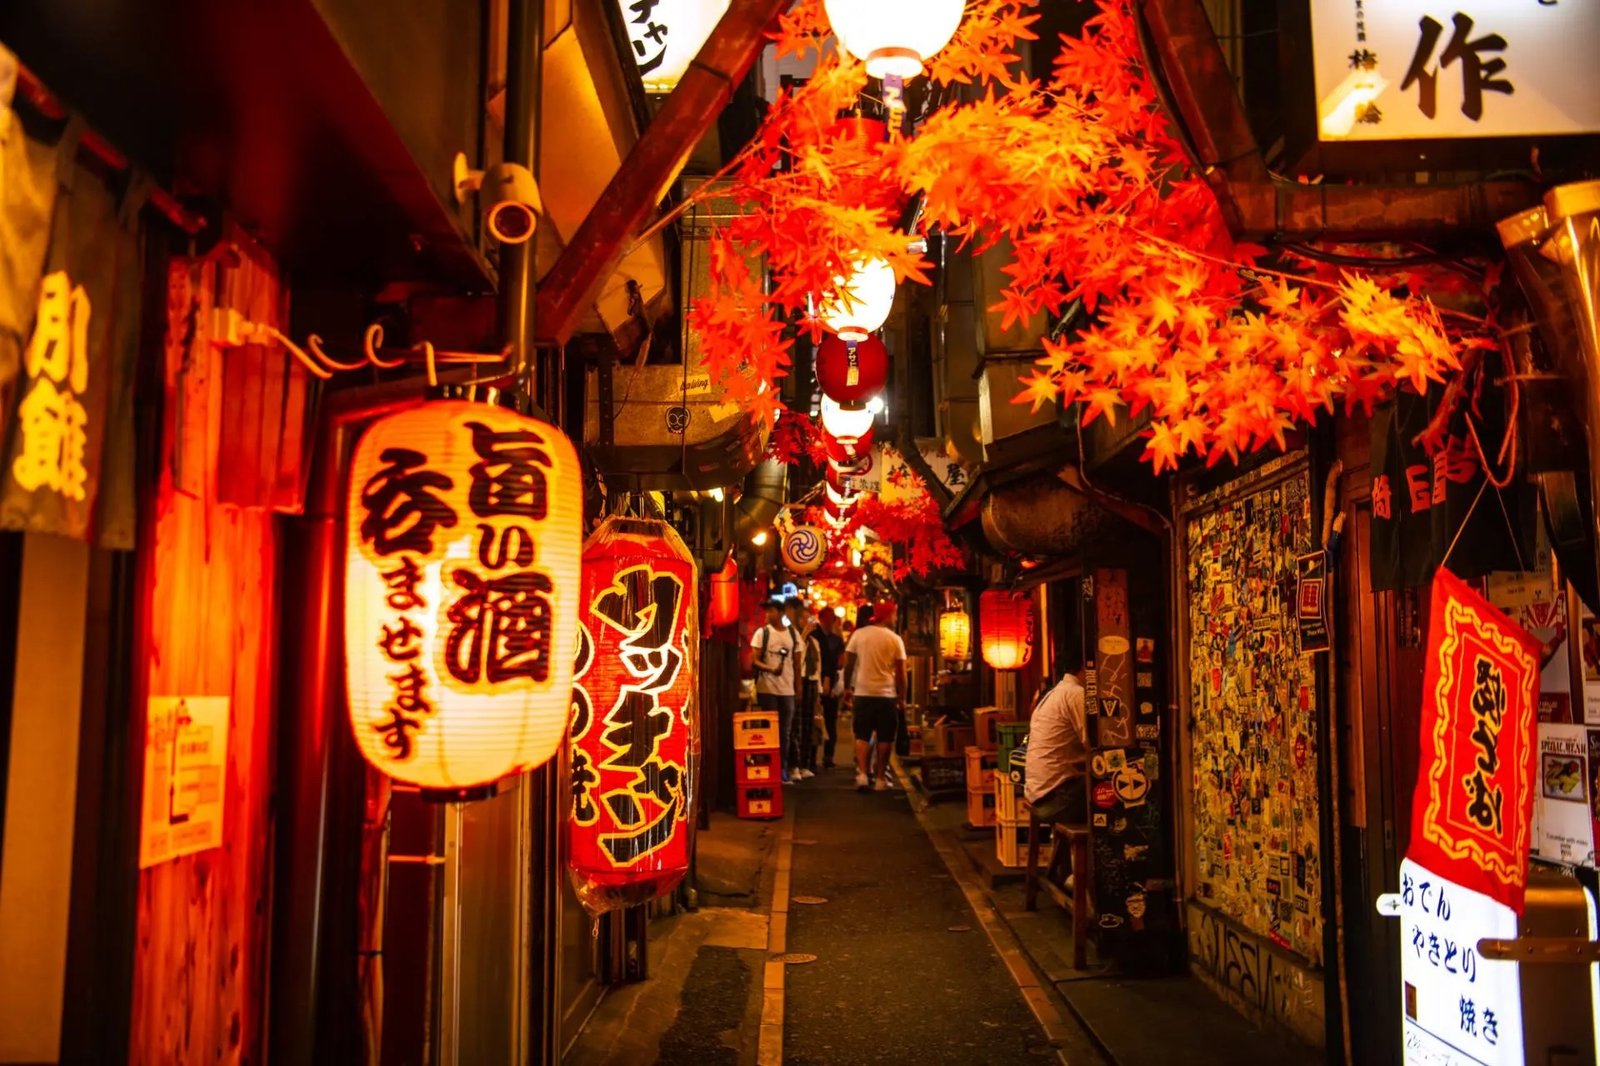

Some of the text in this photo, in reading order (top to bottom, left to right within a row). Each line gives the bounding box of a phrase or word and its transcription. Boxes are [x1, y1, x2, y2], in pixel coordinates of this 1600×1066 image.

[1400, 11, 1515, 122] 作
[360, 448, 458, 759] 呑ませます
[445, 421, 555, 684] 旨い酒
[590, 564, 684, 869] ウッチャン
[1402, 873, 1451, 921] おでん
[1412, 923, 1476, 983] やきとり
[1458, 994, 1499, 1045] 焼き
